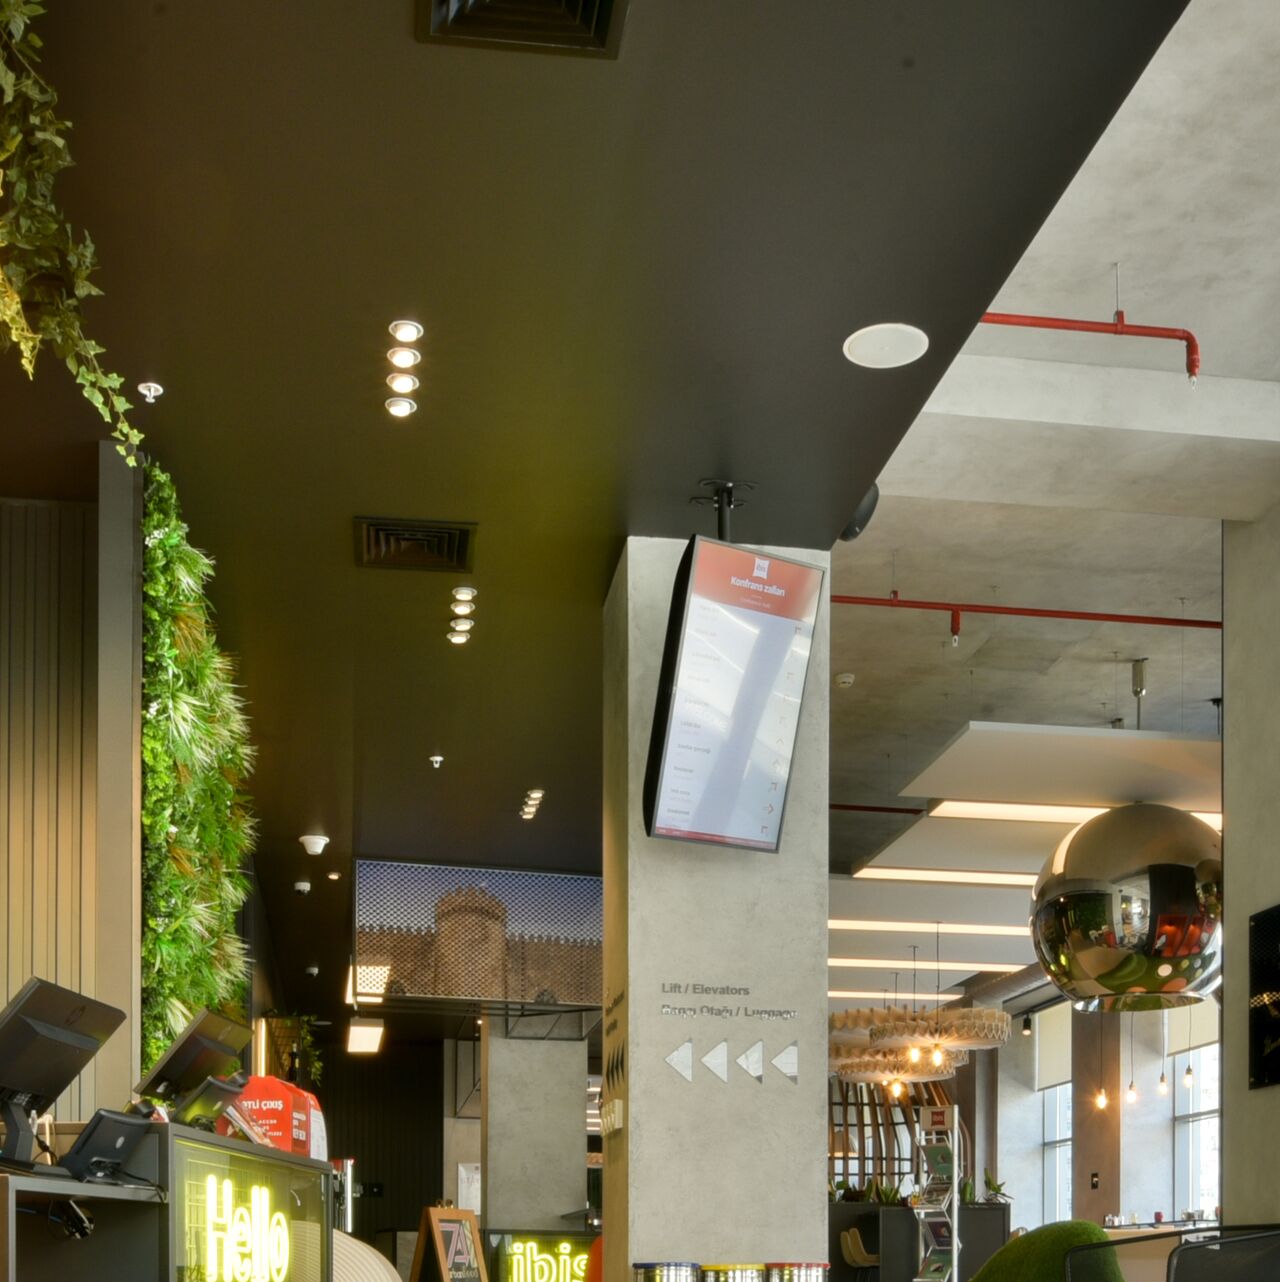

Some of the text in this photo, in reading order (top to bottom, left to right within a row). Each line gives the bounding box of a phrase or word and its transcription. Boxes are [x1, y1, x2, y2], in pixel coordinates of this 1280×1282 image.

[661, 982, 682, 994] Lift
[692, 983, 750, 996] Elevators
[261, 1100, 283, 1111] ÇIXIŞ
